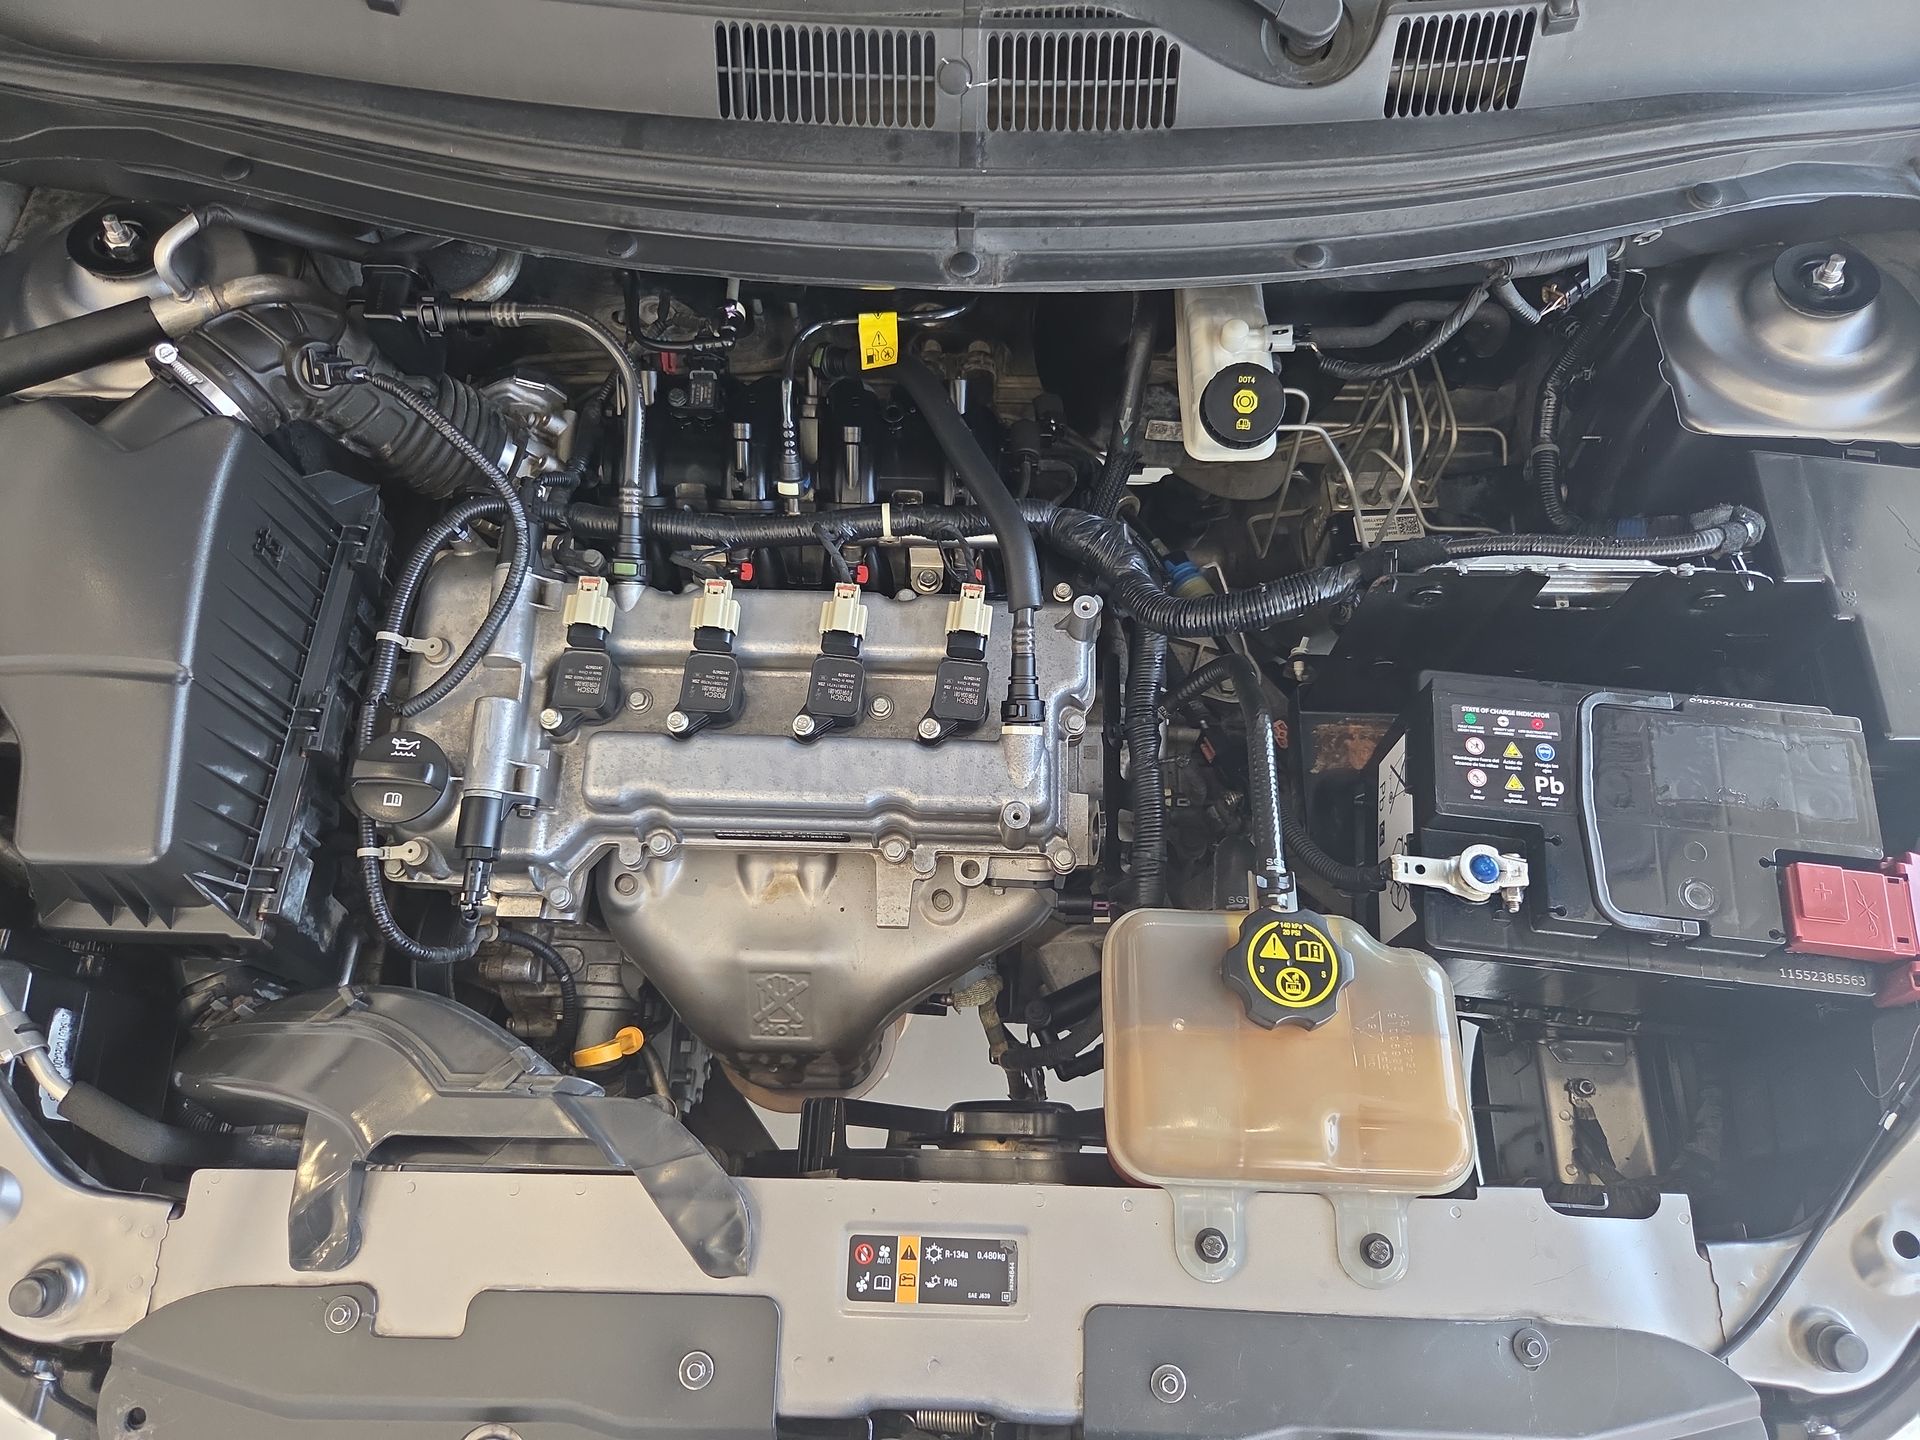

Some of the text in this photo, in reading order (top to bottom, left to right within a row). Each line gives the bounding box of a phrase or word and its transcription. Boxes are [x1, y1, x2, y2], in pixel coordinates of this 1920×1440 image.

[1238, 375, 1255, 384] DOT4
[1535, 776, 1564, 795] Pb
[1779, 967, 1867, 987] 11552385563
[760, 1024, 803, 1036] HOT
[944, 1249, 969, 1259] R-134a
[876, 1257, 891, 1265] AUTO
[943, 1278, 958, 1288] PAG
